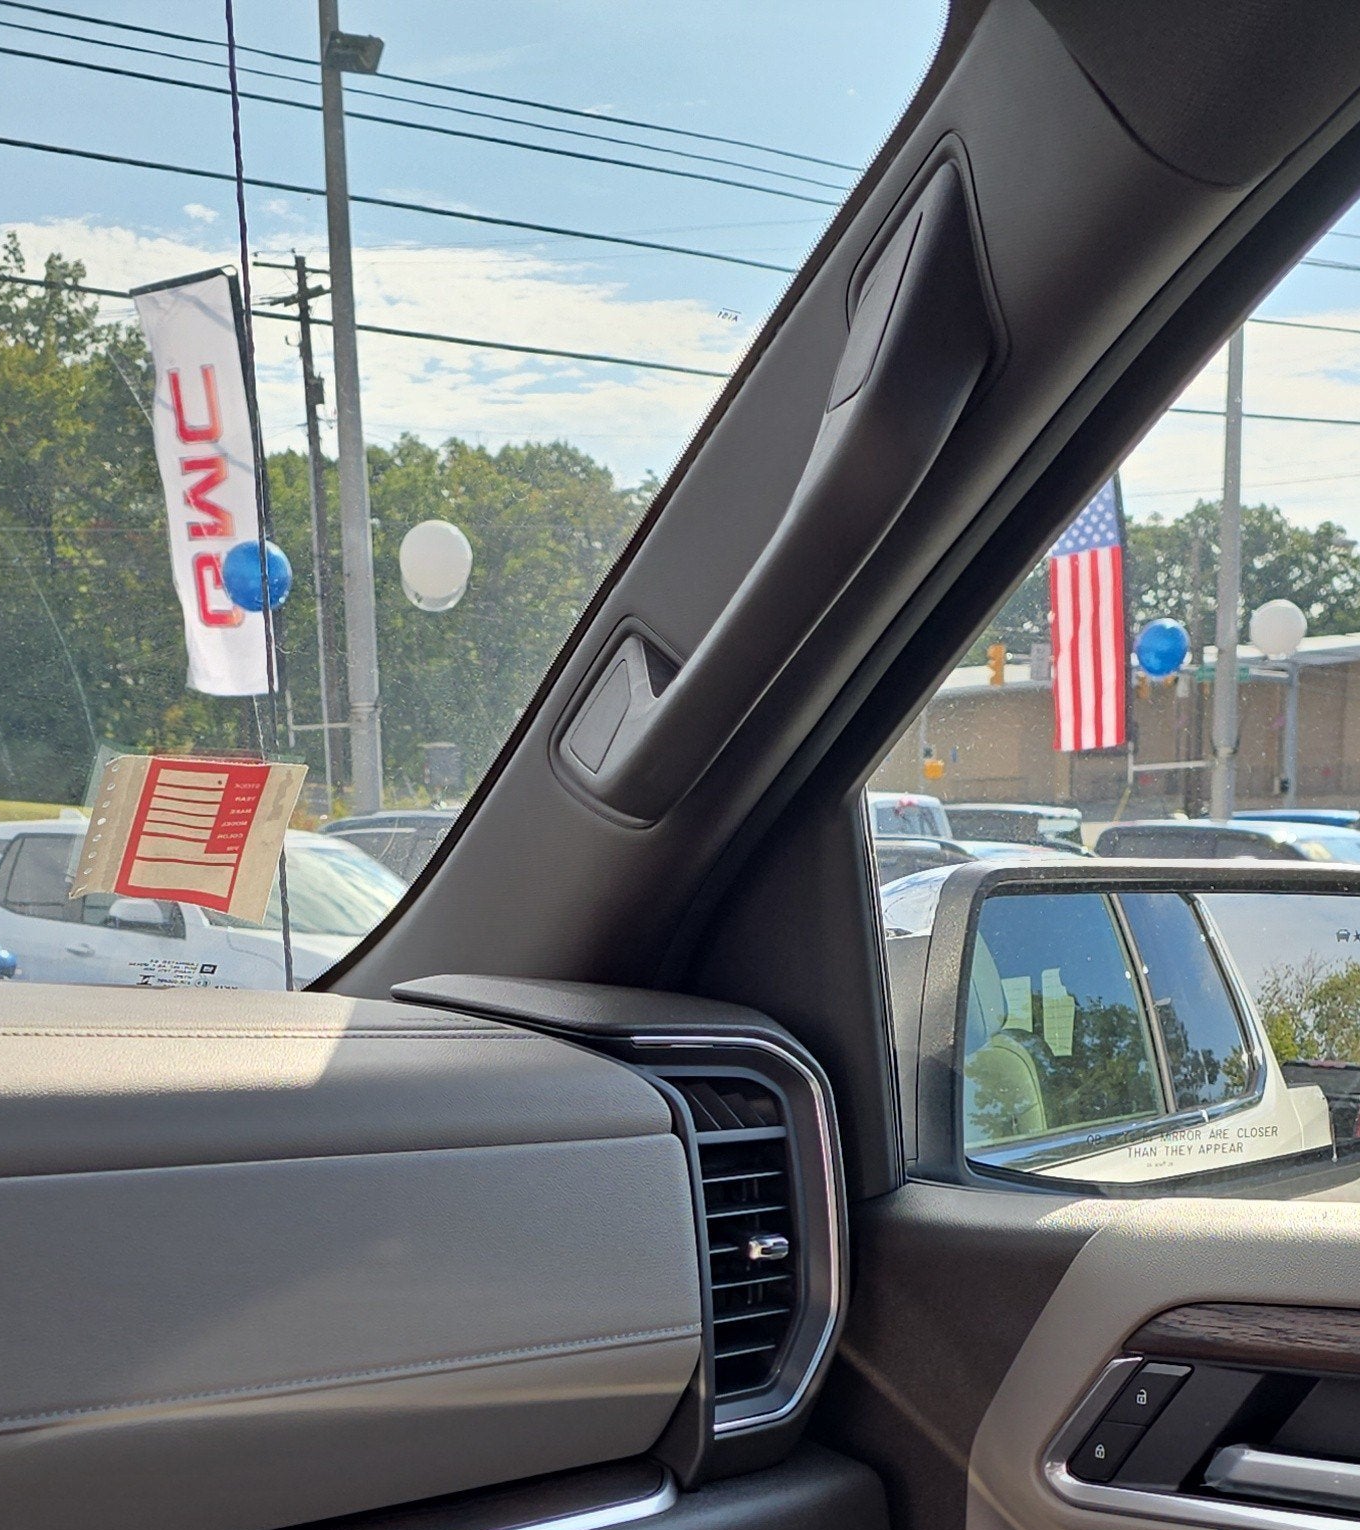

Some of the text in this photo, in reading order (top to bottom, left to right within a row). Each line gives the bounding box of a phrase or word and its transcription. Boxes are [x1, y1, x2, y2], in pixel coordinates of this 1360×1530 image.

[1209, 1128, 1229, 1139] ARE
[1237, 1126, 1279, 1138] CLOSER
[1128, 1142, 1244, 1158] THAN THEY APPEAR
